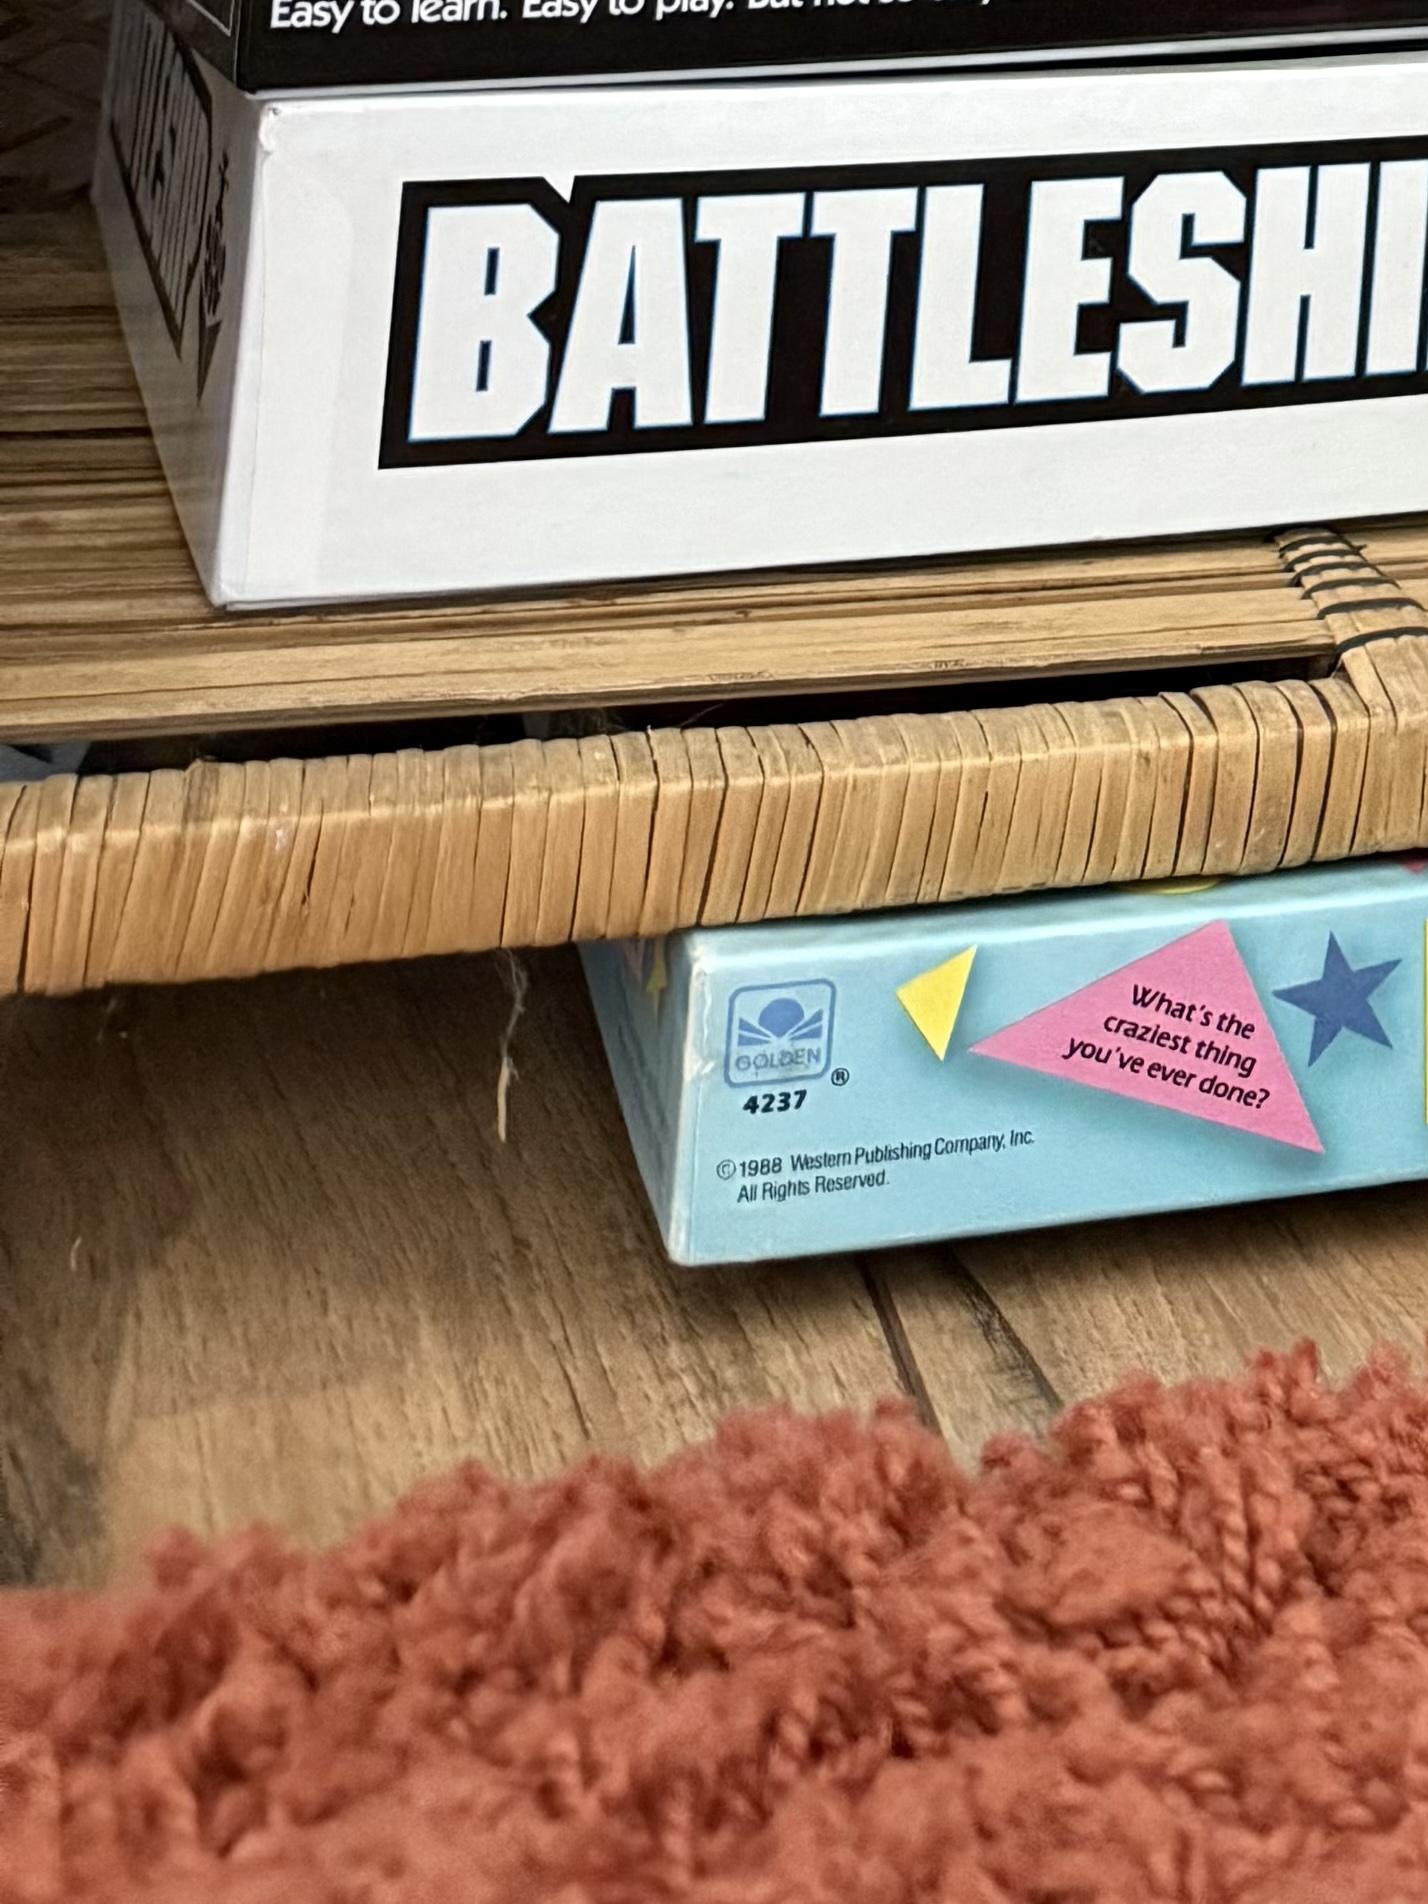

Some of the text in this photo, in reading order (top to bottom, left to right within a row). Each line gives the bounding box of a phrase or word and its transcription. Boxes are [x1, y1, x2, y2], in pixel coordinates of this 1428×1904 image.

[1132, 984, 1256, 1040] What's the
[735, 1047, 822, 1072] GOLDEN
[1103, 1015, 1257, 1078] craziest thing
[1061, 1037, 1271, 1109] you've ever done?
[742, 1089, 808, 1115] 4237
[790, 1150, 852, 1172] Western
[854, 1140, 932, 1167] Publishing
[934, 1132, 1007, 1157] Company,
[1009, 1128, 1036, 1147] Inc.
[737, 1169, 891, 1204] All Rights Reserved.
